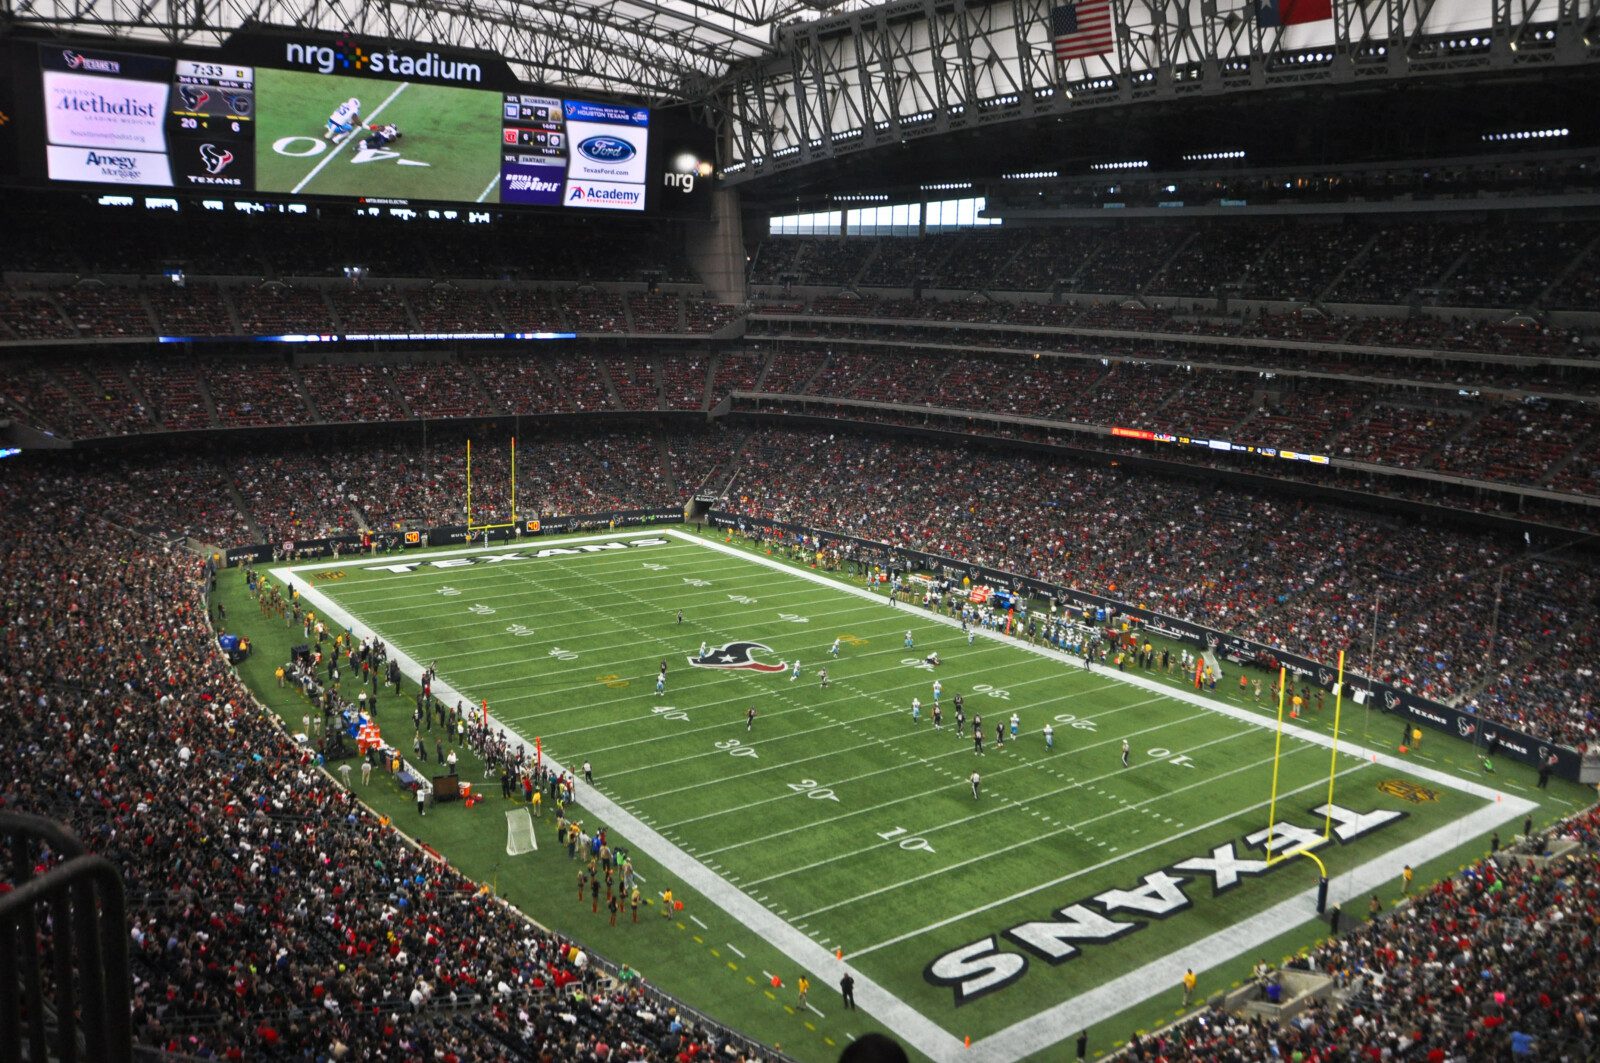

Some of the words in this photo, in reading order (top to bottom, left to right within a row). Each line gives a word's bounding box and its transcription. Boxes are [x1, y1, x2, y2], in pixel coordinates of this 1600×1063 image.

[192, 64, 223, 77] 7:33
[286, 43, 335, 74] nrg
[369, 52, 481, 82] stadium
[56, 94, 154, 118] Methodist
[180, 117, 198, 129] 20
[577, 110, 606, 118] HOUSTON
[607, 112, 630, 121] TEXANS
[231, 121, 241, 133] 6
[591, 140, 622, 156] Ford
[86, 151, 137, 170] Amegy
[583, 167, 629, 177] TexasFord.com
[187, 175, 241, 186] TEXANS
[664, 173, 694, 193] nrg
[587, 187, 640, 204] Academy
[528, 521, 540, 531] 40
[405, 532, 419, 542] 40
[362, 537, 670, 575] TEXANS
[1170, 626, 1200, 641] TEXANS
[651, 705, 687, 720] 40
[1408, 704, 1448, 725] TEXANS
[714, 738, 755, 757] 30
[786, 778, 834, 800] 20
[876, 825, 929, 851] 10
[925, 802, 1410, 1008] TEXANS
